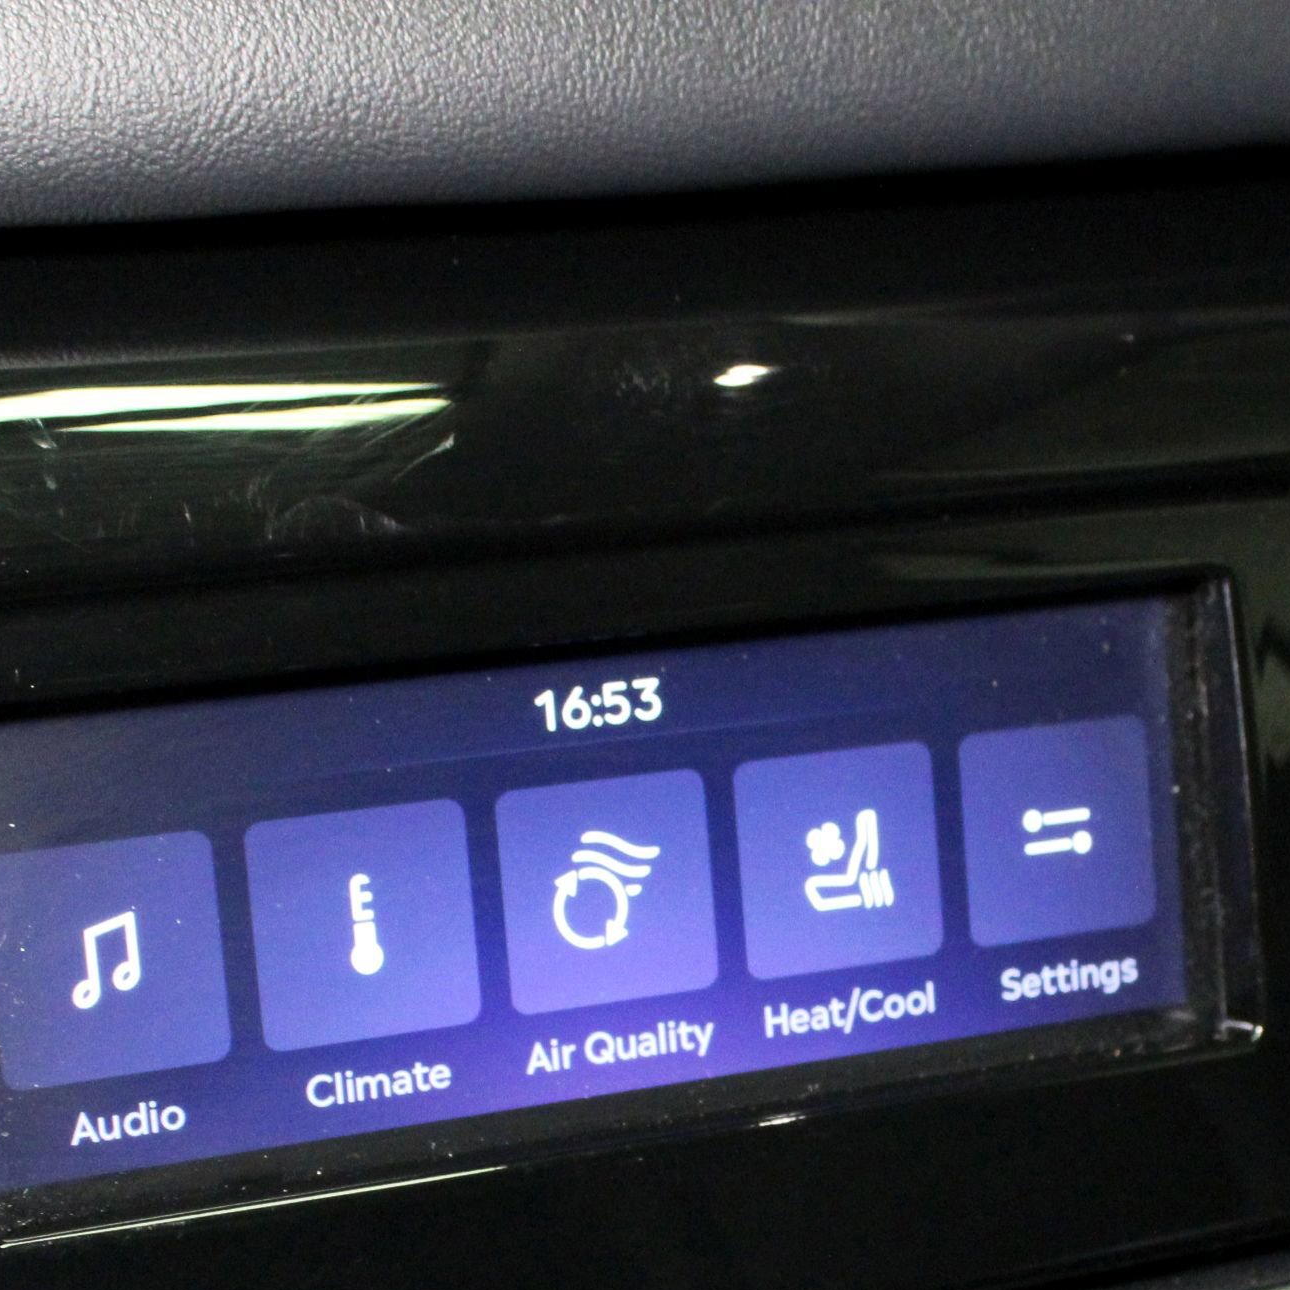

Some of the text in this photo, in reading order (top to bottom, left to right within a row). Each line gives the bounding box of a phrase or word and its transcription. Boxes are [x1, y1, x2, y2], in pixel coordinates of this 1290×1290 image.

[533, 676, 664, 734] 16:53
[1000, 955, 1140, 1003] Settings
[763, 980, 937, 1039] Heat/Cool
[526, 1018, 715, 1076] Air Quality
[305, 1060, 452, 1109] Climate
[70, 1100, 187, 1147] Audio
